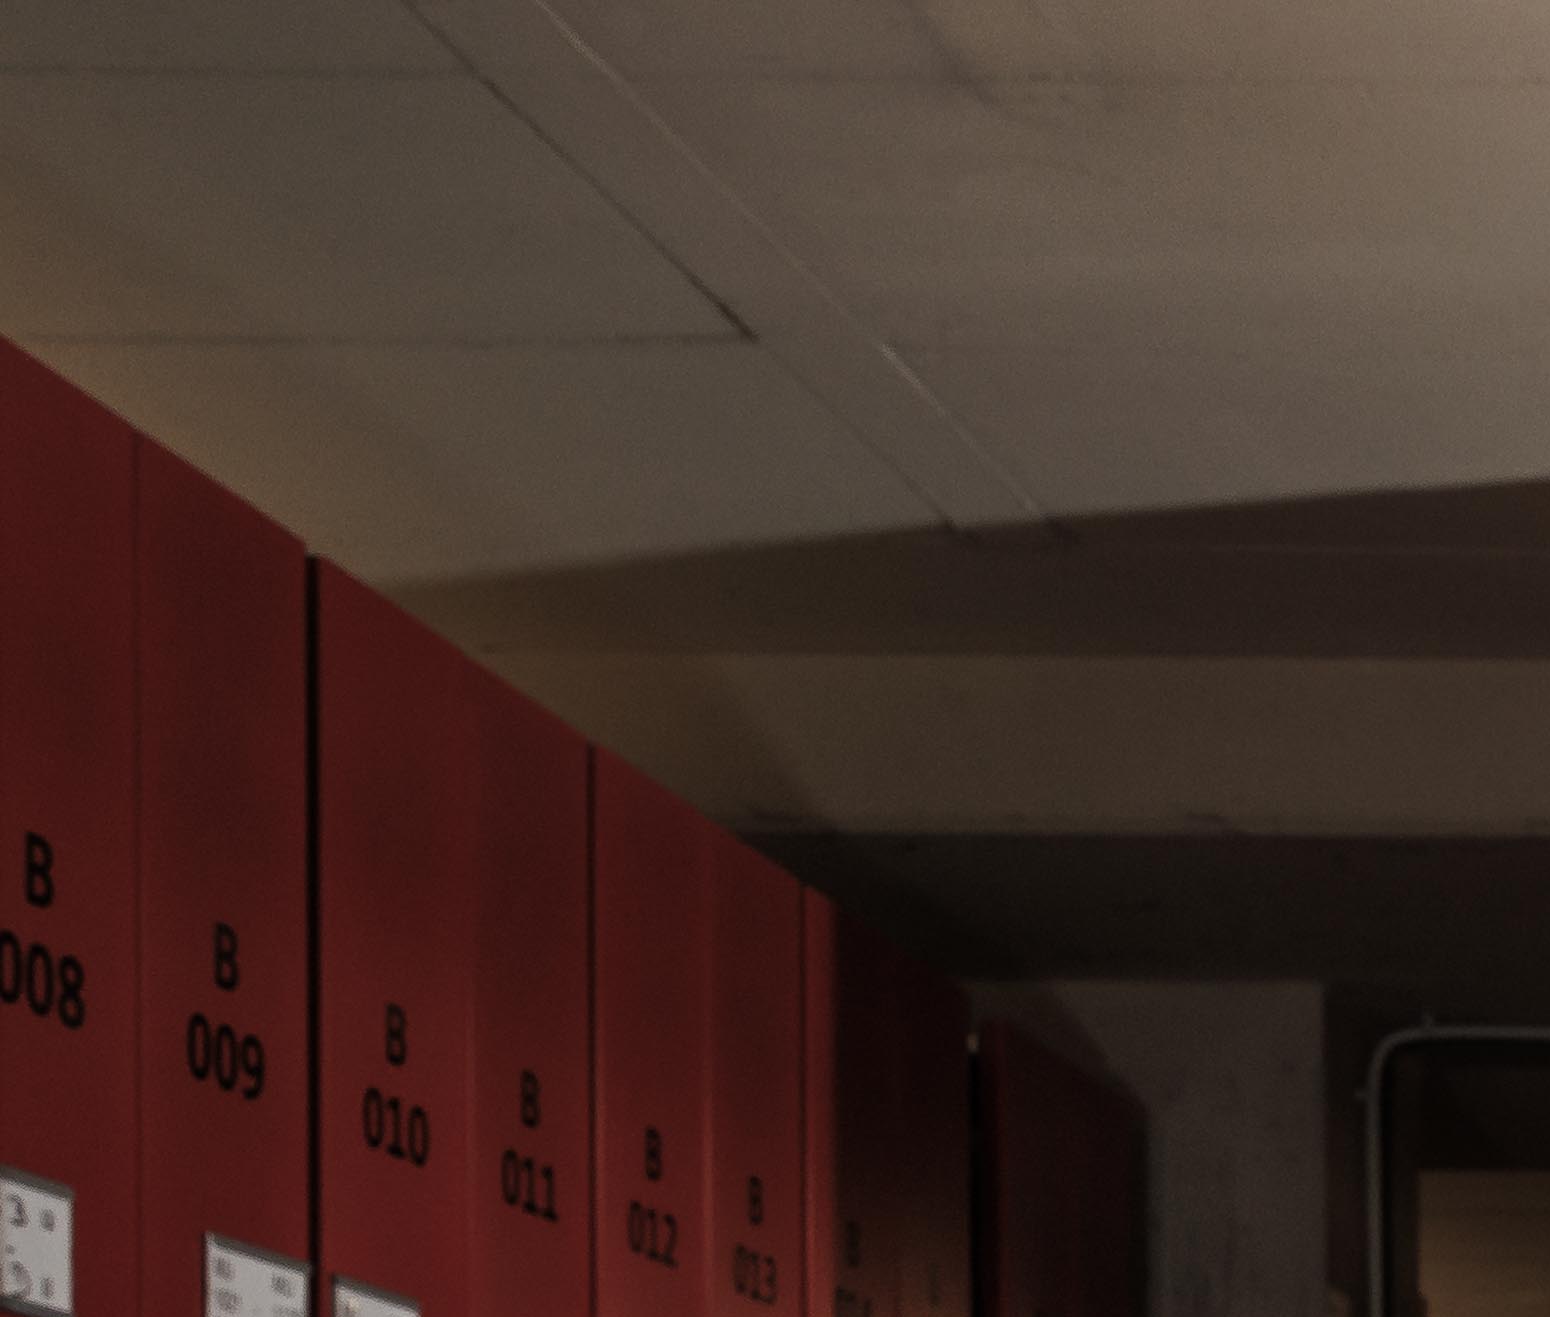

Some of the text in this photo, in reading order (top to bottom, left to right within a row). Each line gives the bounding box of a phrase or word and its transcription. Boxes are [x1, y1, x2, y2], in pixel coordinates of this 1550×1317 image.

[23, 832, 54, 907] B
[0, 931, 86, 1029] 008
[213, 922, 241, 992] B
[186, 1013, 266, 1101] 009
[385, 1004, 409, 1067] B
[362, 1087, 432, 1168] 010
[519, 1070, 542, 1128] B
[501, 1150, 559, 1223] 011
[644, 1127, 664, 1183] B
[626, 1201, 680, 1269] 012
[747, 1175, 765, 1226] B
